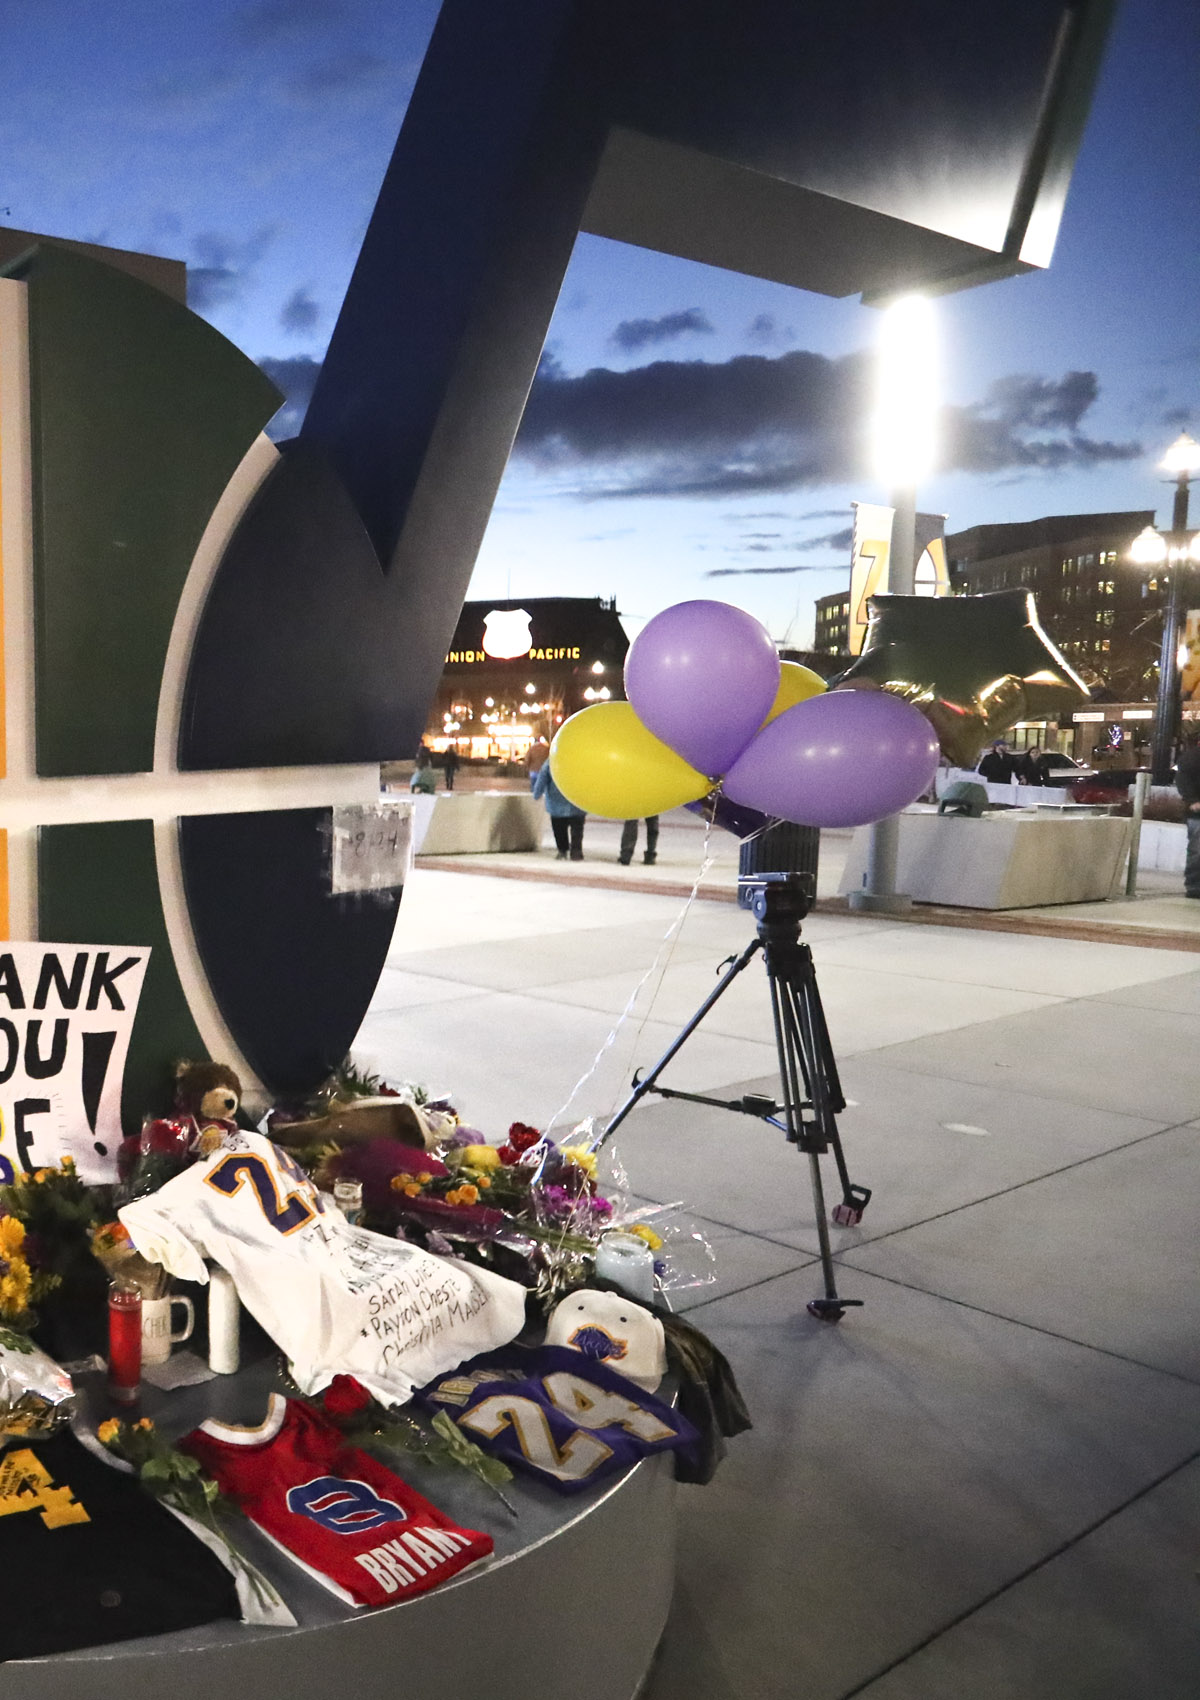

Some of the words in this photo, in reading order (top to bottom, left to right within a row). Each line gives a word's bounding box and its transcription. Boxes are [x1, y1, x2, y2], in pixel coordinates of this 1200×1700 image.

[529, 647, 581, 661] PACIFIC
[456, 1371, 678, 1482] 24
[354, 1526, 473, 1595] BRYANT
